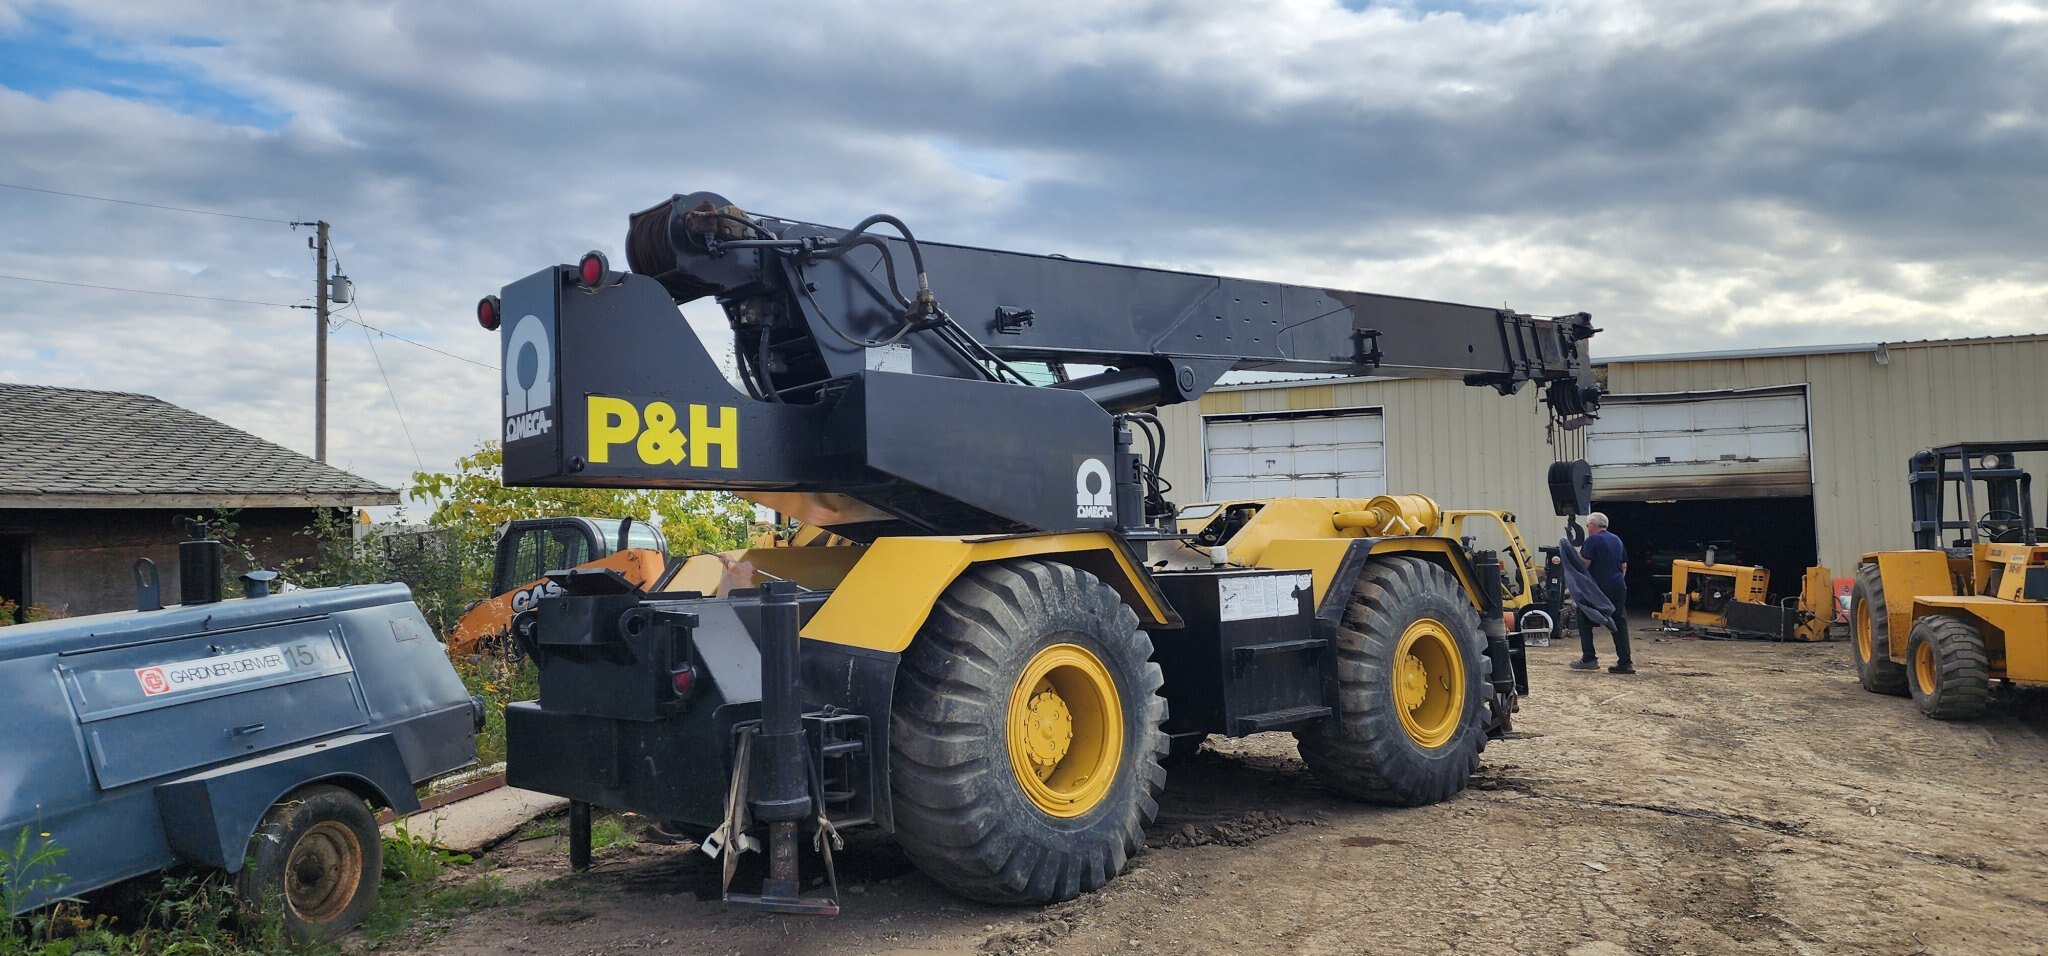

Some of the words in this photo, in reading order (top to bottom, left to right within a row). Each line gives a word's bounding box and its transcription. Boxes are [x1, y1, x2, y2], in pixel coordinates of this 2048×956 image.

[505, 410, 552, 443] OMEGA
[587, 395, 738, 469] P&H
[1076, 505, 1113, 519] OMEGA
[511, 579, 568, 613] CAS
[170, 654, 284, 684] GARDNER-DENVER
